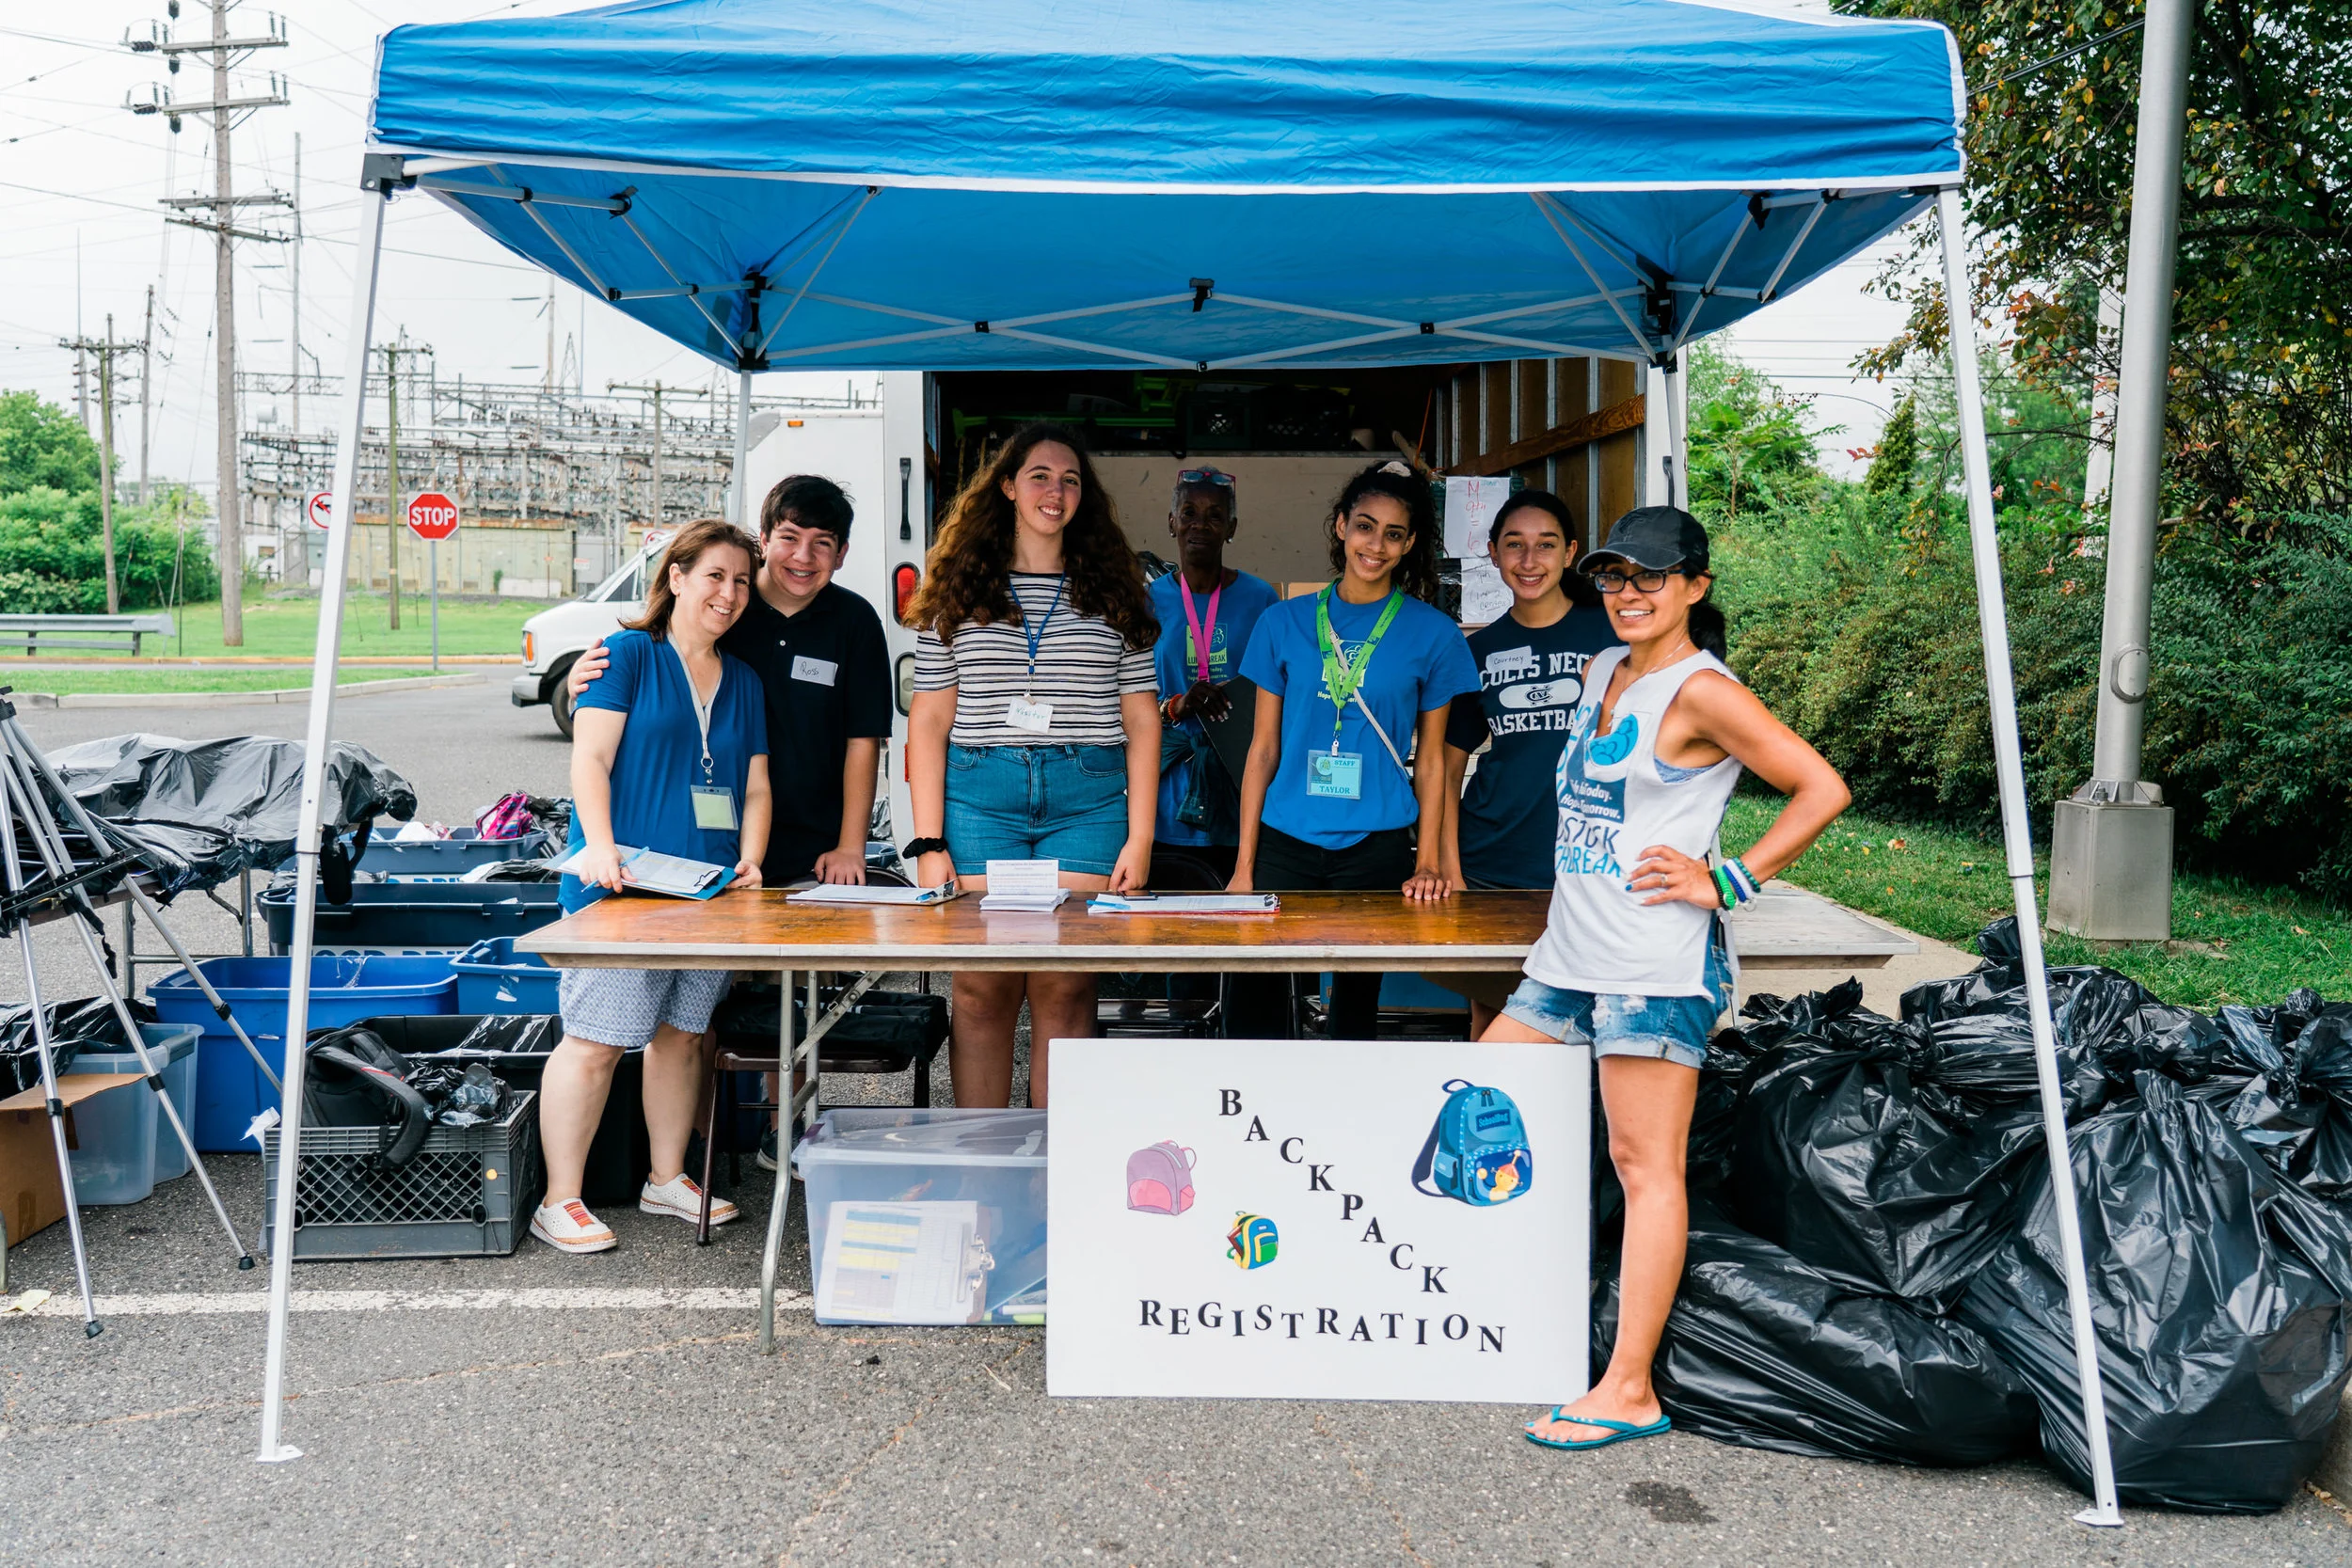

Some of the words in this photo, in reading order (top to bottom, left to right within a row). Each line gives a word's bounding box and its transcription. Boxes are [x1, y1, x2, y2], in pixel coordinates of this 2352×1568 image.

[411, 507, 455, 526] STOP
[800, 660, 819, 676] Ross
[1493, 655, 1524, 666] Courtney
[1319, 785, 1351, 795] TAYLOR
[1219, 1088, 1449, 1294] BACKPACK
[1138, 1299, 1507, 1354] REGISTRATION
